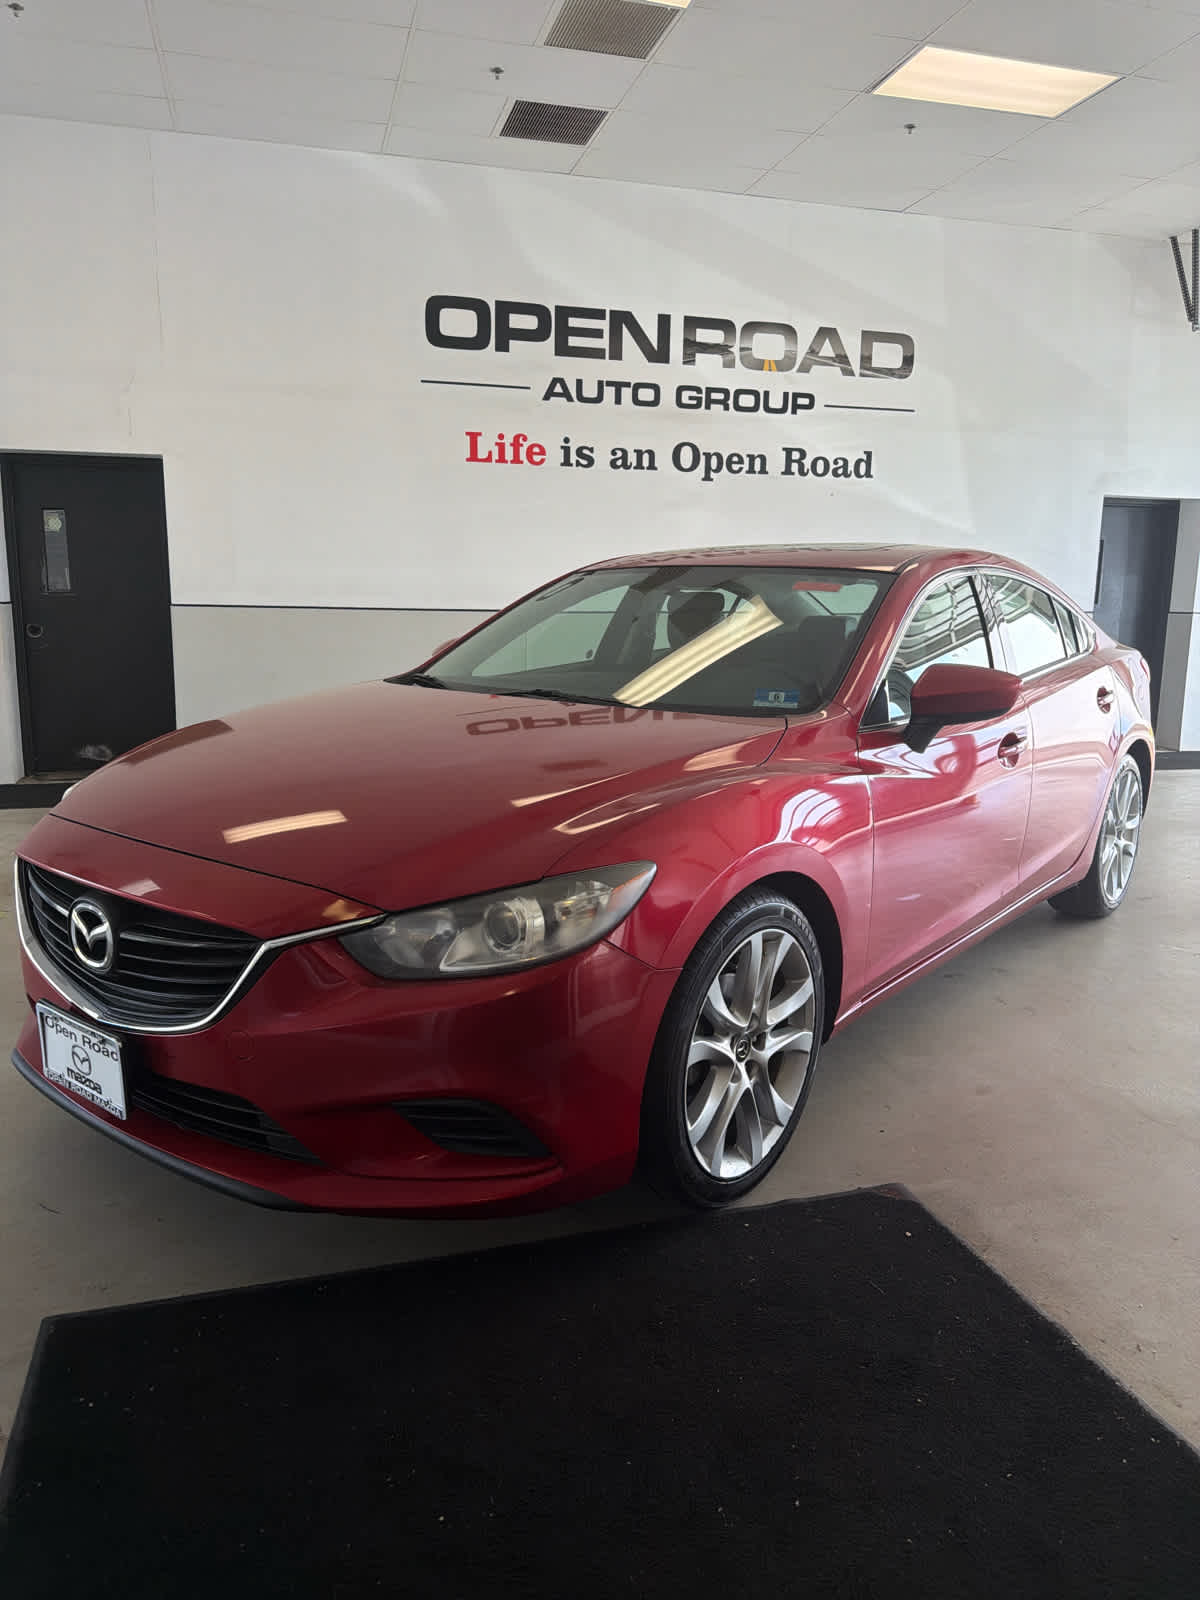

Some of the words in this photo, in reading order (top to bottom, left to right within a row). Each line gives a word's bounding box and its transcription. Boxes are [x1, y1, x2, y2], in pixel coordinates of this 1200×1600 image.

[424, 294, 672, 365] OPEN
[682, 315, 915, 380] ROAD
[541, 376, 661, 408] AUTO
[675, 384, 816, 416] GROUP
[464, 431, 547, 467] Life
[559, 436, 595, 469] is
[609, 447, 658, 471] an
[671, 441, 769, 482] Open
[780, 447, 874, 480] Road
[45, 1015, 77, 1042] Open
